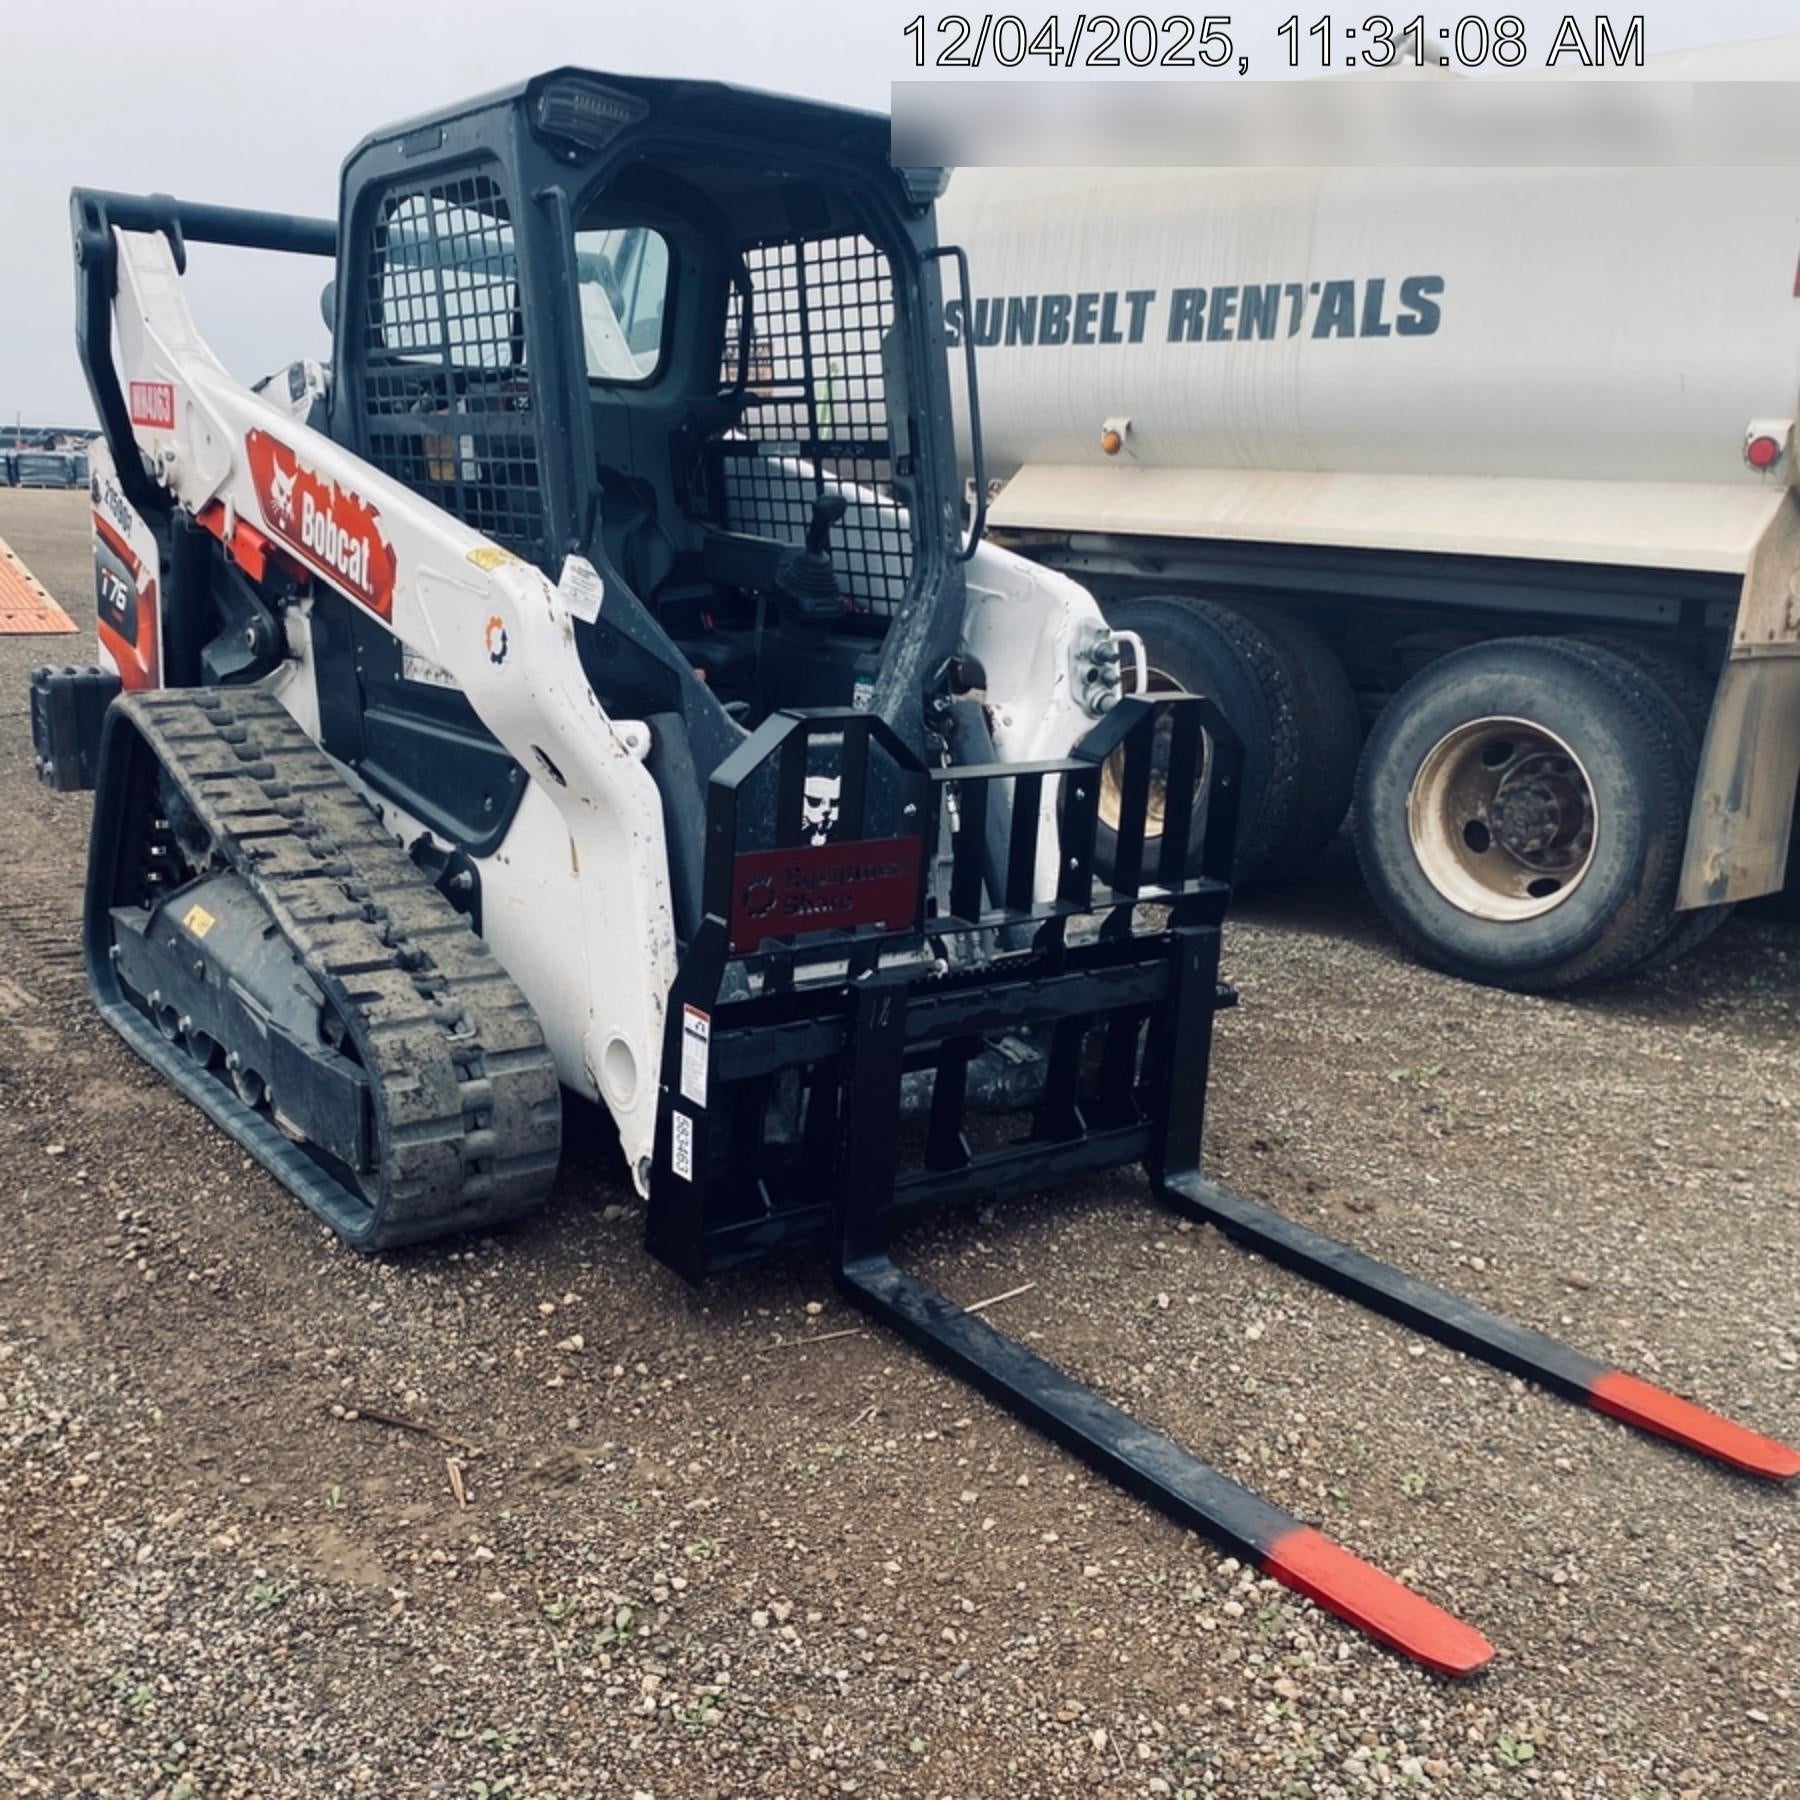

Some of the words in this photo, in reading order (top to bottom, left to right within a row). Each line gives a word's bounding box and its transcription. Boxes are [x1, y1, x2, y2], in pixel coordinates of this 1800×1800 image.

[944, 289, 1157, 347] SUNBELT
[1166, 274, 1445, 343] RENTALS
[301, 490, 370, 591] Bobcat
